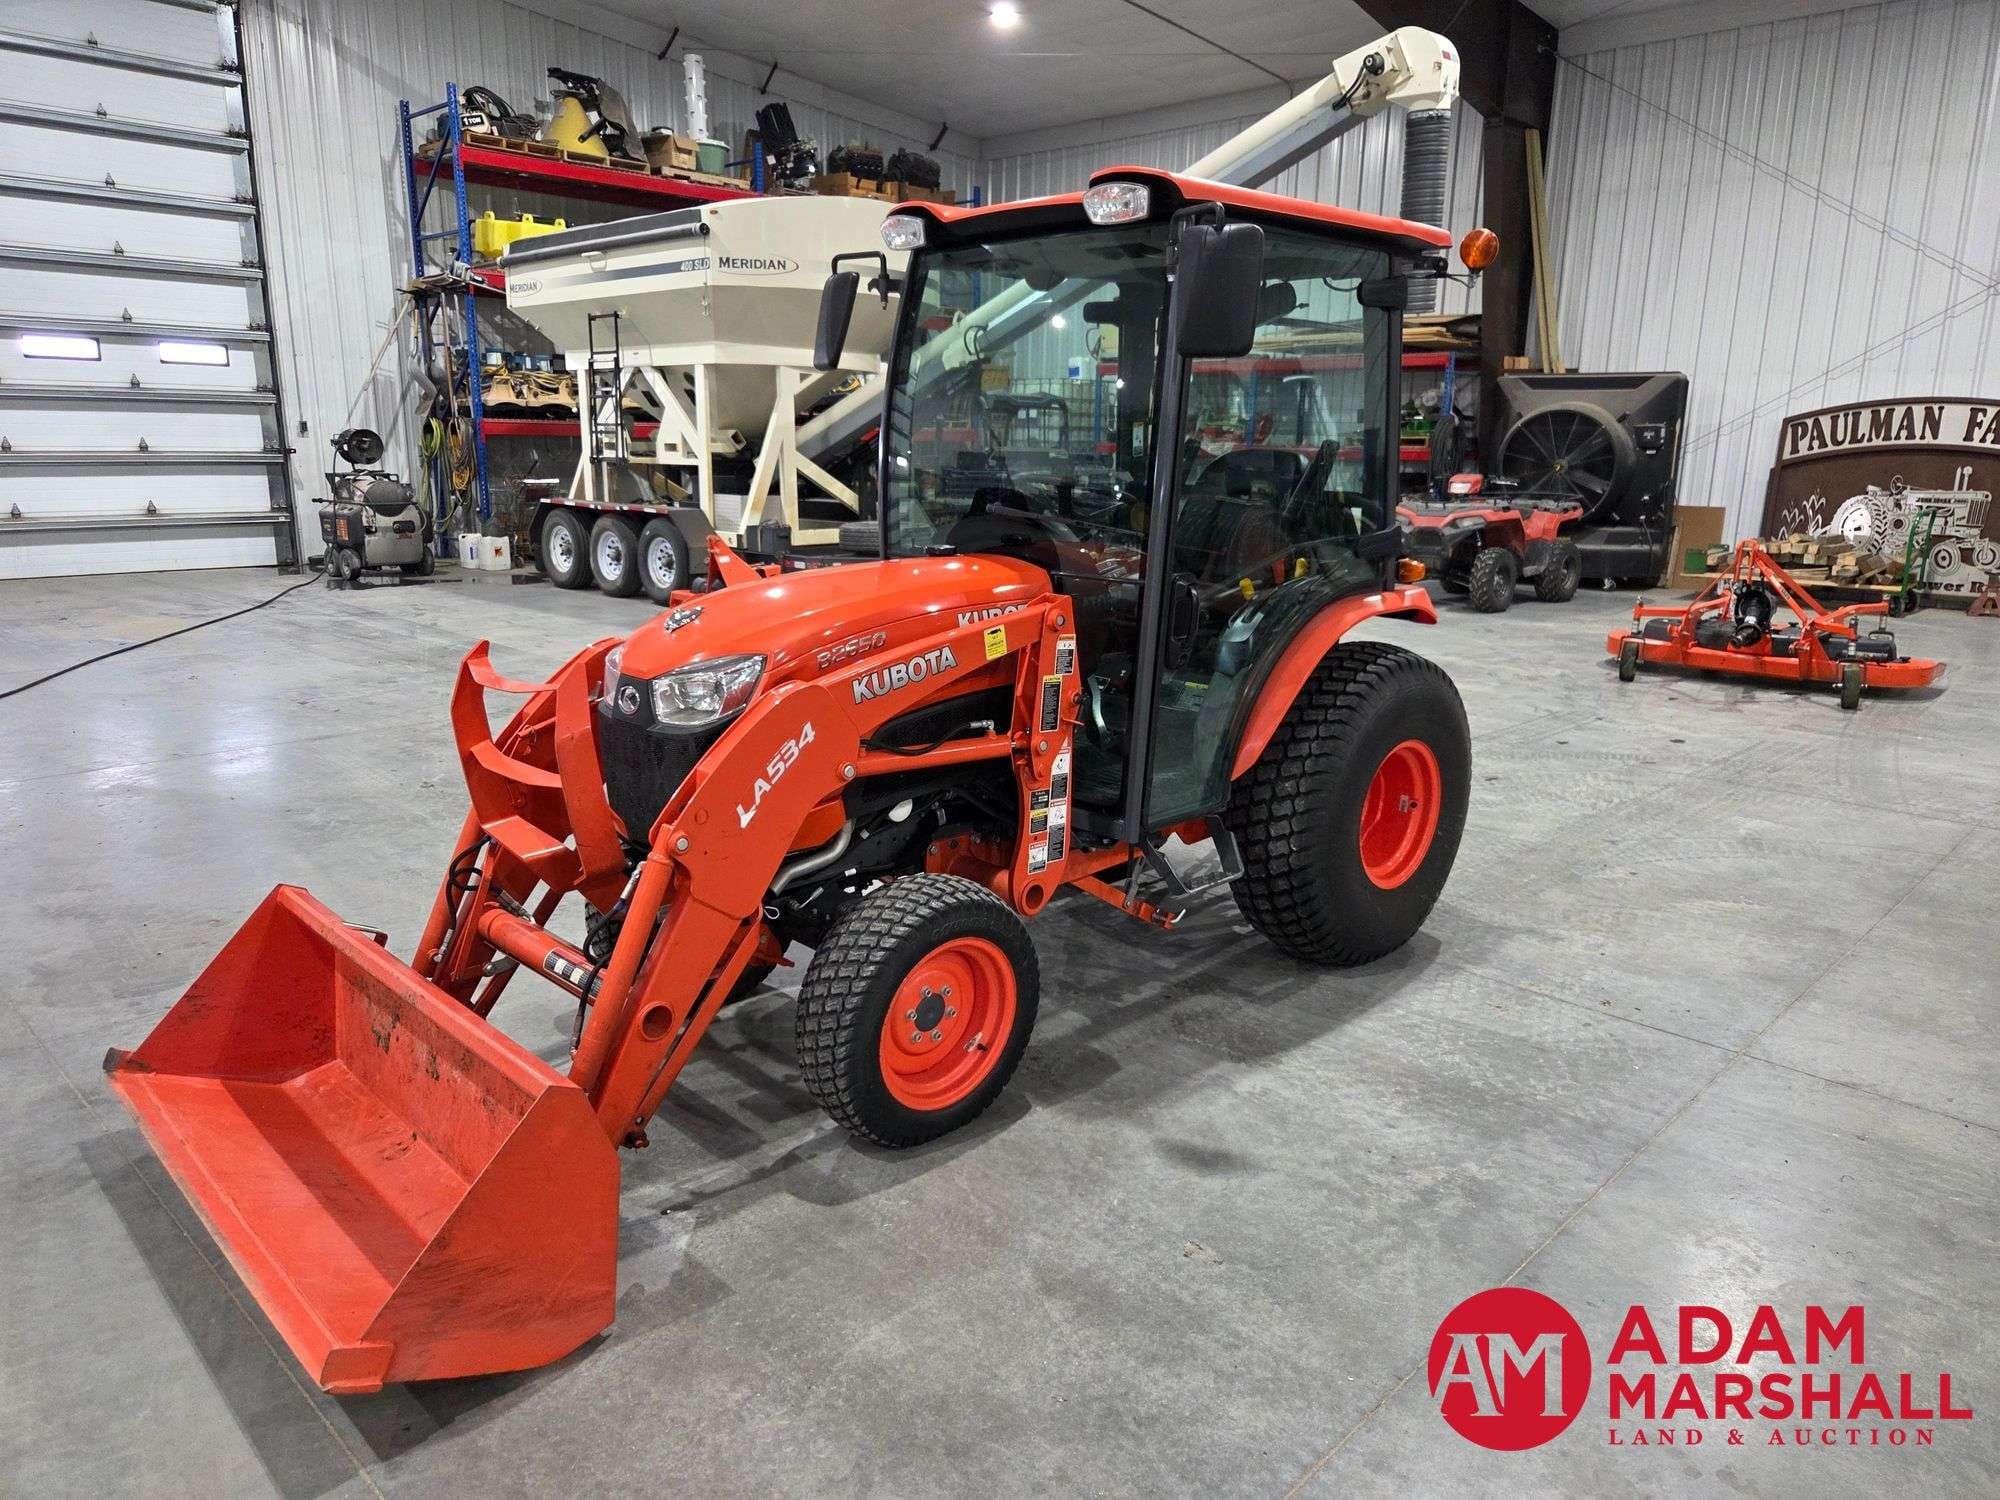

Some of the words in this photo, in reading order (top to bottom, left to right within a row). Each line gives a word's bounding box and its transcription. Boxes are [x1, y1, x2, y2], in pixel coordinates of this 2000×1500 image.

[463, 117, 469, 125] 1
[719, 256, 786, 270] MERIDIAN
[1789, 406, 1944, 455] PAULMAN
[852, 645, 957, 704] KUBOTA
[736, 720, 816, 829] LA534
